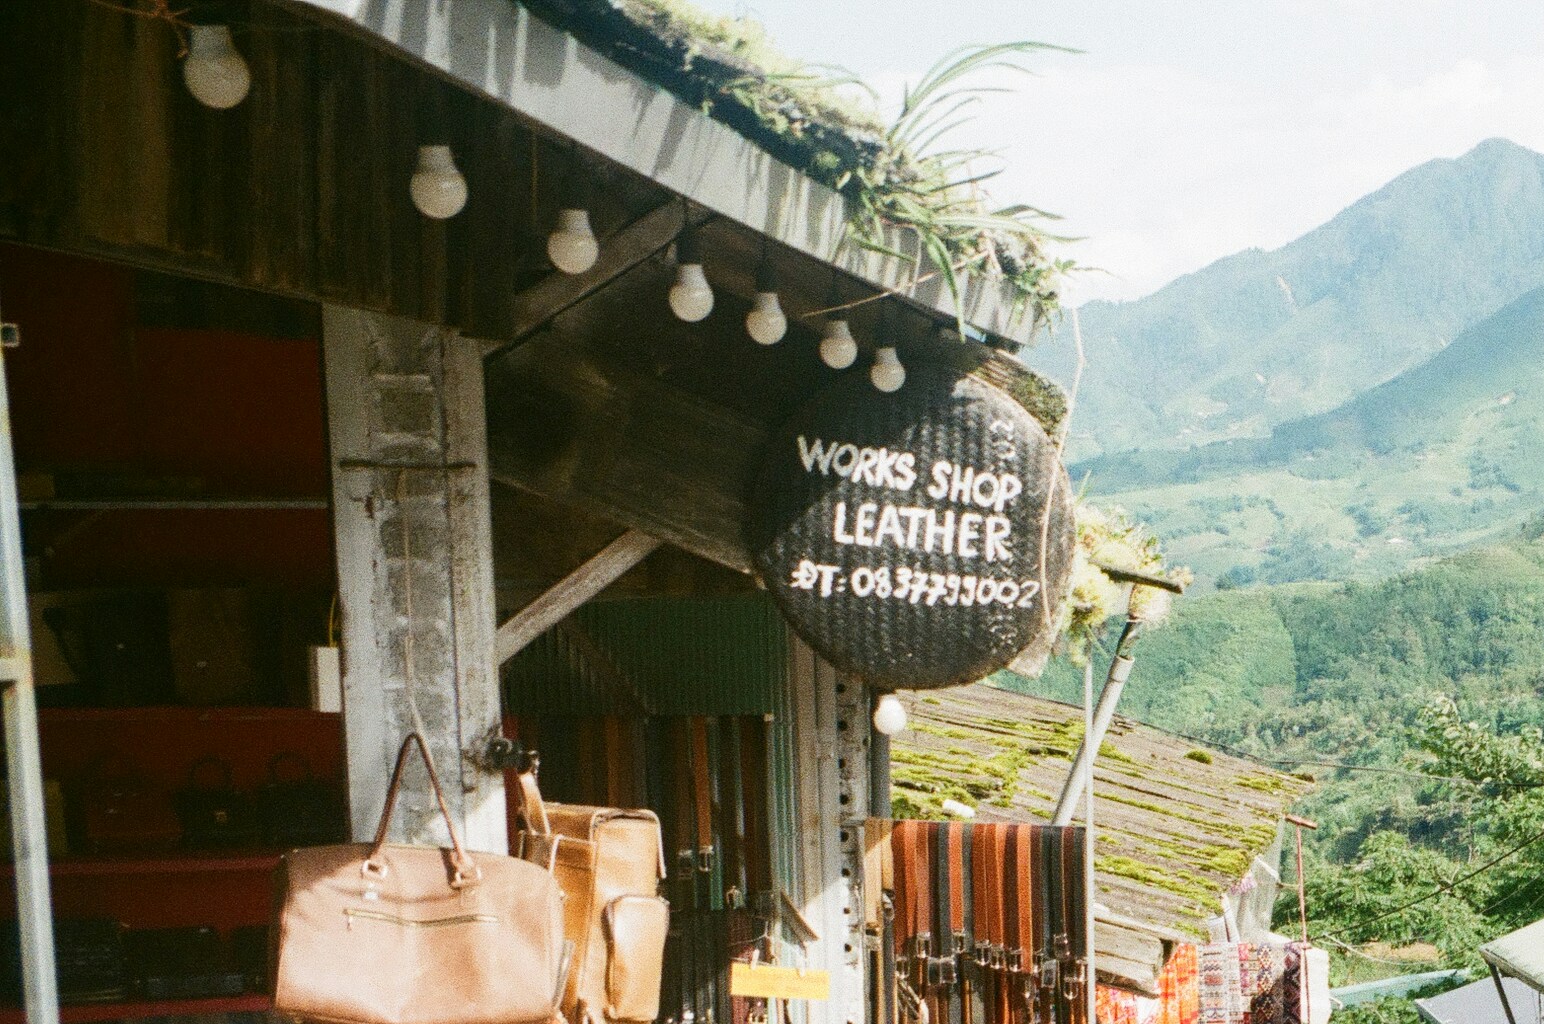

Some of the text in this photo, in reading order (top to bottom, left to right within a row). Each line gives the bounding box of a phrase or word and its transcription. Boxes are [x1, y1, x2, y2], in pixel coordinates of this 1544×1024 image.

[797, 434, 1022, 512] WORKS SHOP
[834, 502, 1013, 562] LEATHER
